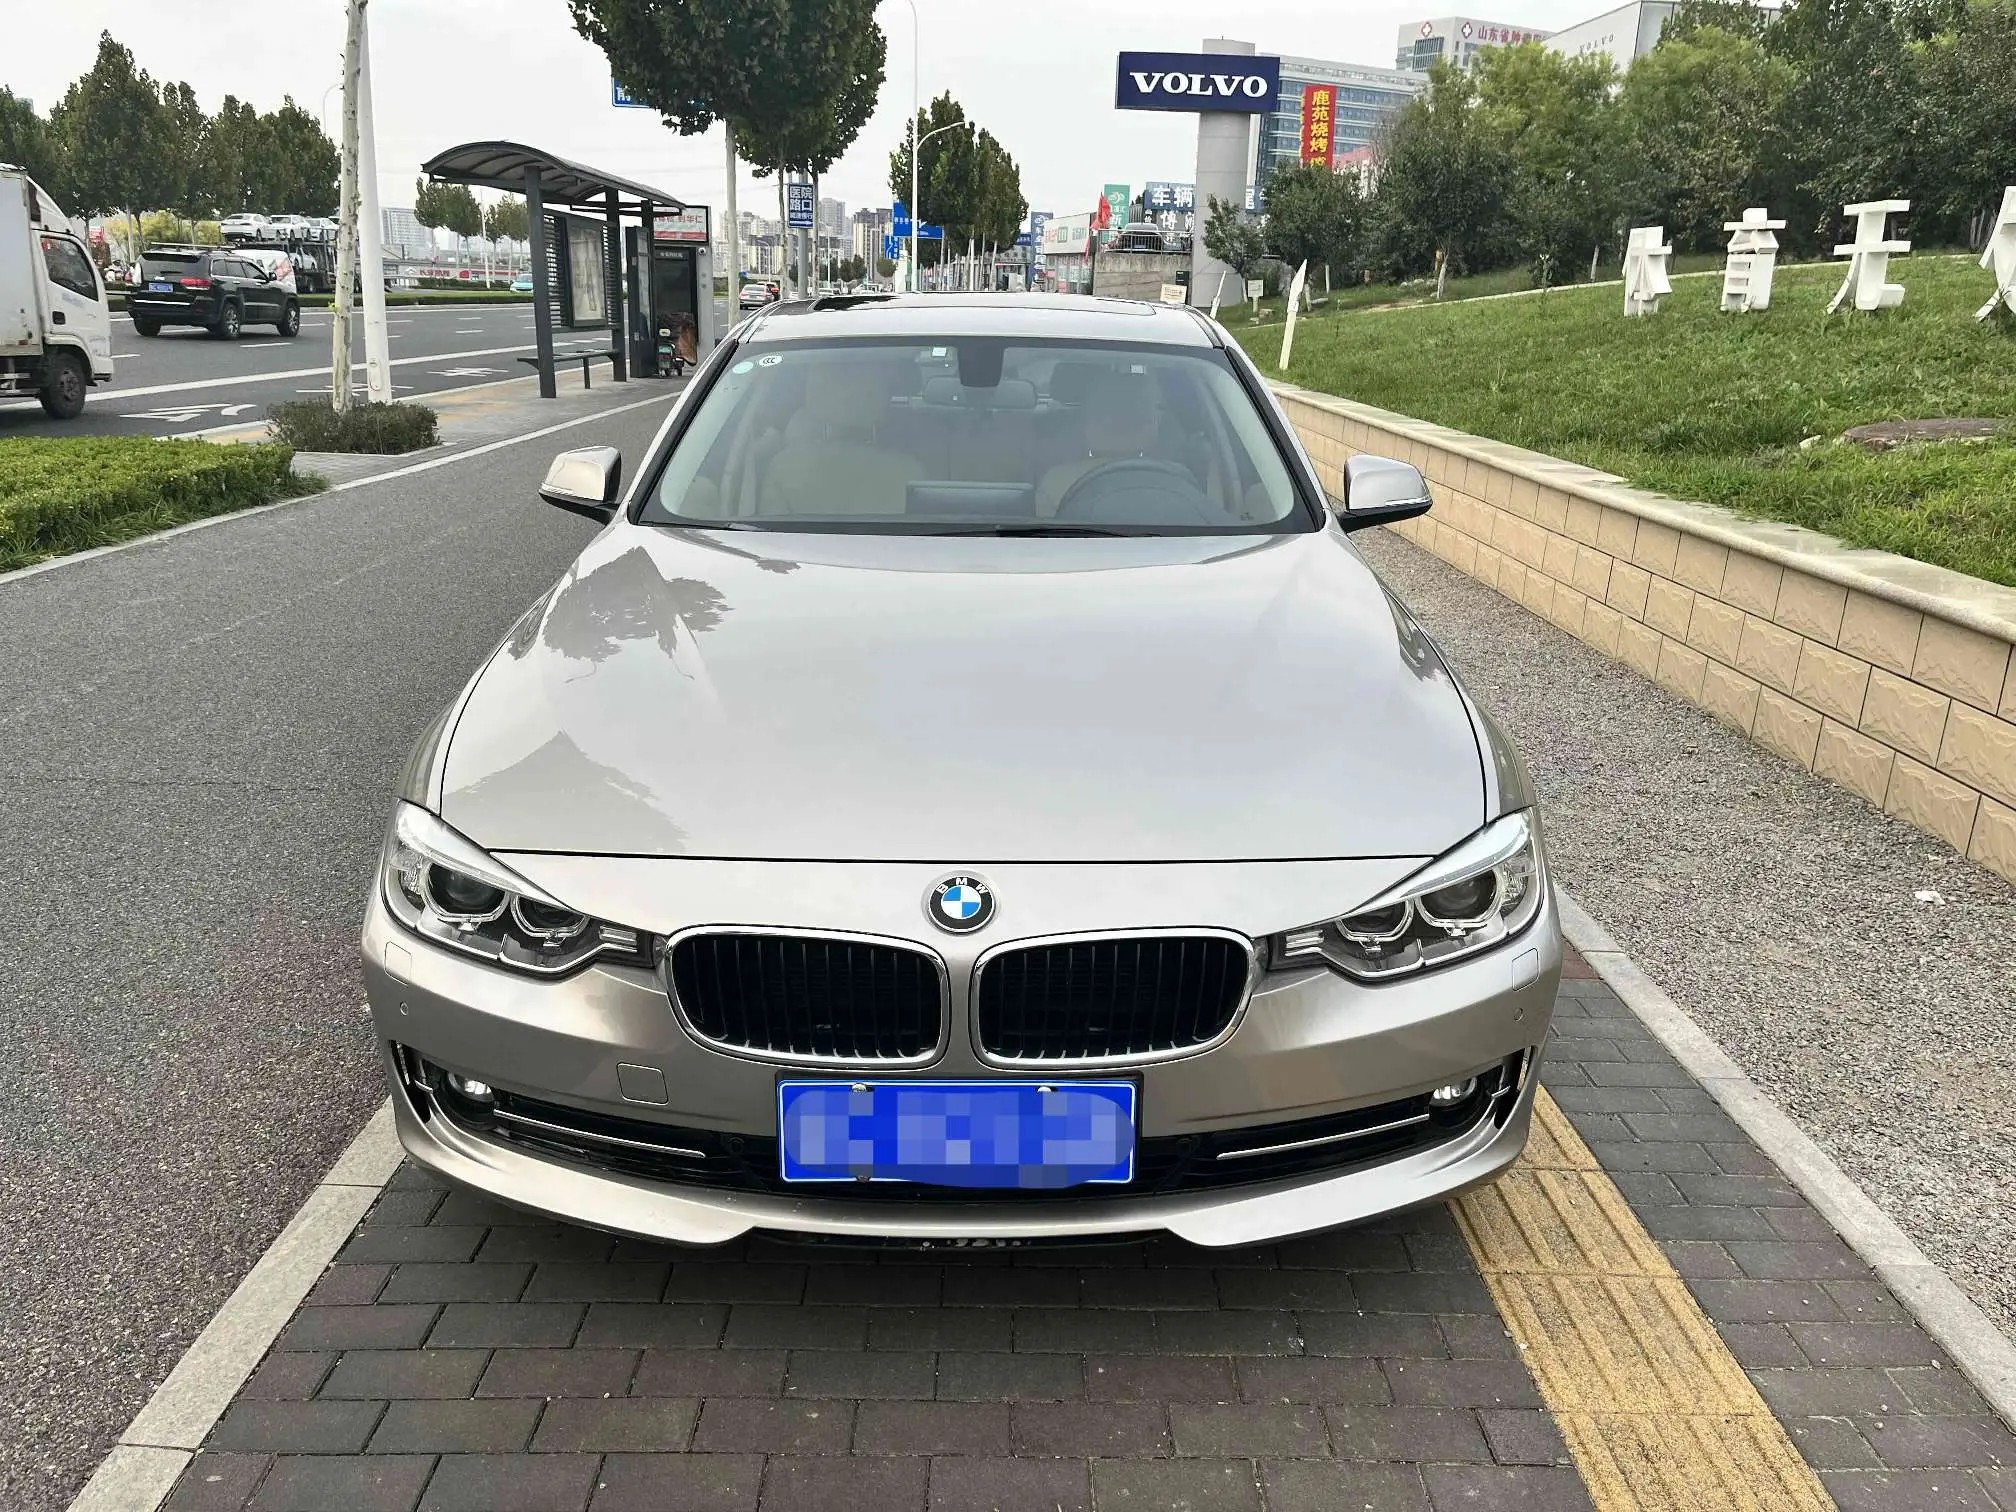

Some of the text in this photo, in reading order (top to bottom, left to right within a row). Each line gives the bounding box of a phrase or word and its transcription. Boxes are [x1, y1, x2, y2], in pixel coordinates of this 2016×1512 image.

[1579, 33, 1614, 52] VOLVO
[1130, 72, 1268, 98] VOLVO
[790, 186, 813, 199] 医院
[1151, 185, 1194, 207] 车辆
[790, 199, 813, 211] 路口
[936, 877, 989, 894] BMW
